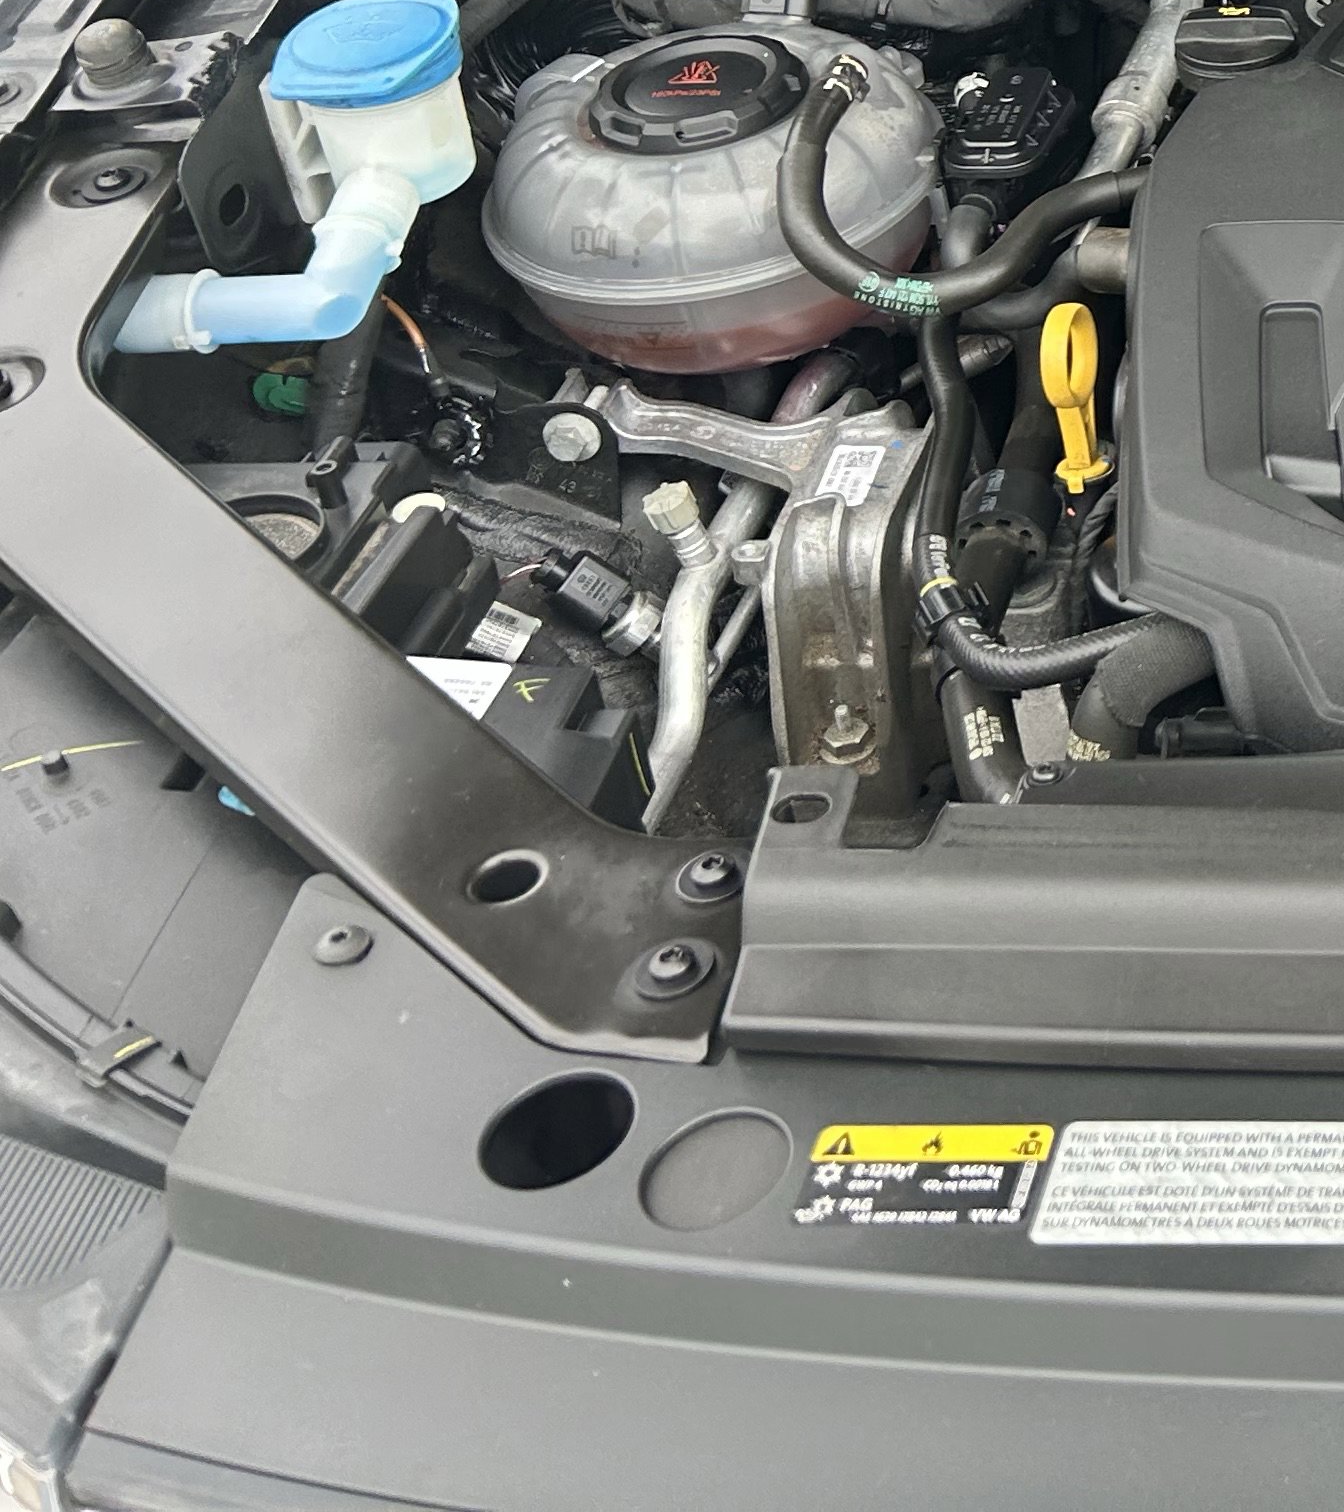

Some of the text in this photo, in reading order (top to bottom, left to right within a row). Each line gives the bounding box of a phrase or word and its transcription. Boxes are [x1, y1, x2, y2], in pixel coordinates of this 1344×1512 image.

[1071, 1132, 1099, 1143] THIS
[1104, 1132, 1157, 1143] VEHICLE
[1160, 1132, 1172, 1143] IS
[1176, 1132, 1243, 1144] EQUIPPED
[1246, 1133, 1282, 1144] WITH
[1283, 1133, 1294, 1144] A
[1142, 1147, 1181, 1158] DRIVE
[1185, 1147, 1234, 1158] SYSTEM
[1236, 1148, 1269, 1158] AND
[1271, 1148, 1283, 1158] IS
[1286, 1148, 1337, 1158] EXEMPT
[1061, 1161, 1115, 1172] TESTING
[1119, 1161, 1141, 1172] ON
[1231, 1162, 1275, 1173] DRIVE
[1051, 1186, 1067, 1197] CE
[1137, 1186, 1159, 1197] EST
[1296, 1187, 1316, 1198] DE
[839, 1197, 873, 1213] PAG
[1119, 1201, 1197, 1212] PERMANENT
[1199, 1202, 1216, 1212] ET
[967, 1208, 997, 1224] VW
[997, 1208, 1021, 1224] AG
[1041, 1216, 1069, 1228] SUR
[1196, 1217, 1234, 1228] DEUX
[1236, 1217, 1282, 1228] ROUES
